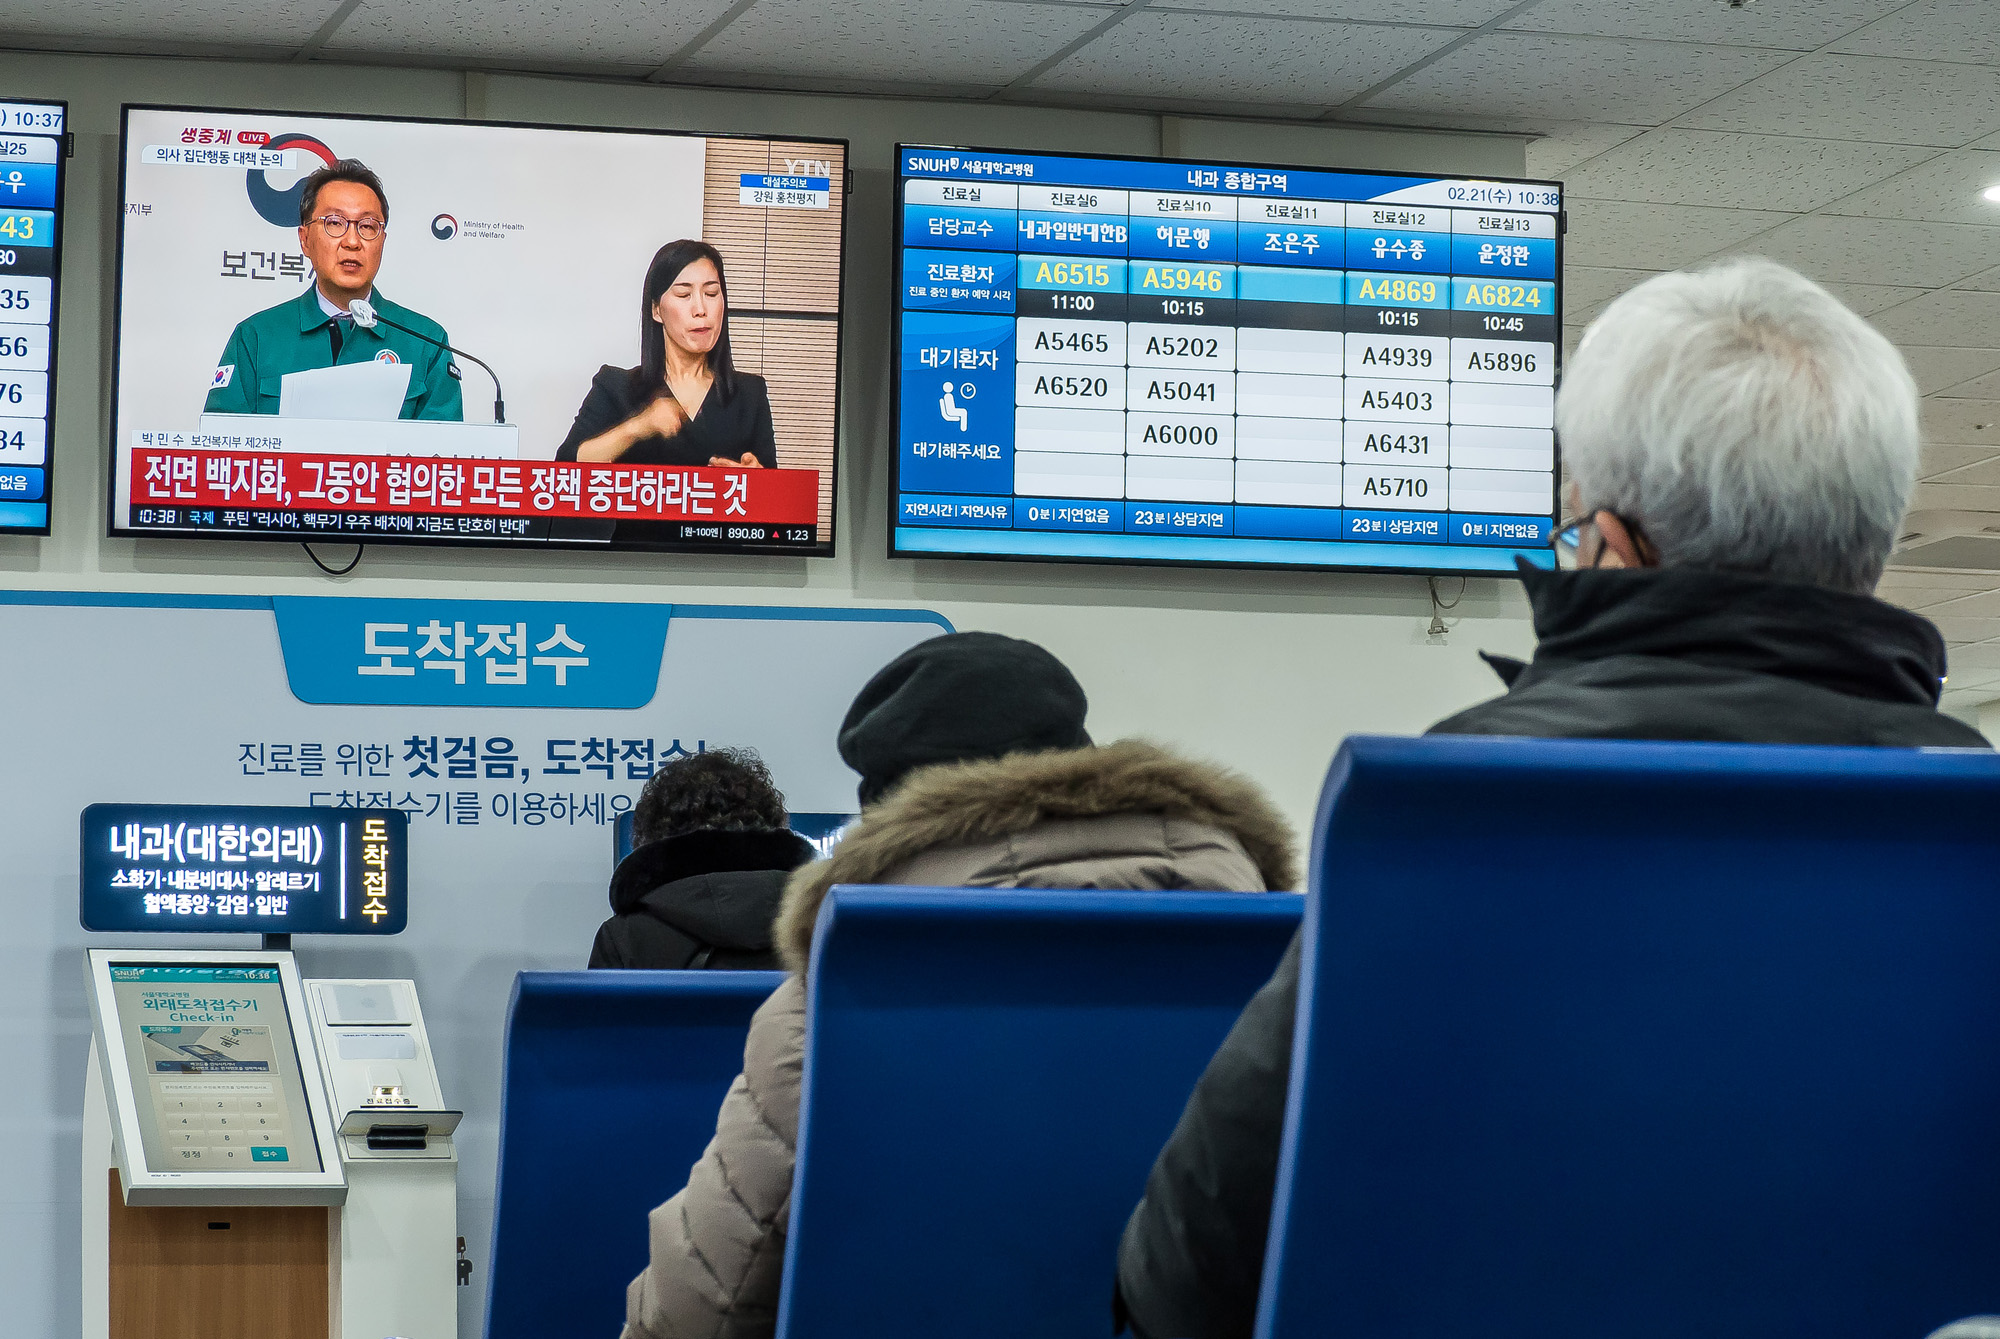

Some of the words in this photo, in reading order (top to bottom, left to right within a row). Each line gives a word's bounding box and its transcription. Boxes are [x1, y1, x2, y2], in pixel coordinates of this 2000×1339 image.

[15, 111, 62, 128] 10:37
[181, 127, 232, 145] 생중계
[242, 133, 266, 143] LIVE
[157, 148, 181, 163] 의사
[184, 149, 231, 165] 집단행동
[233, 151, 257, 167] 대책
[259, 153, 283, 167] 논의
[908, 157, 950, 172] SNUH
[961, 160, 1034, 177] 서울대학교병원
[784, 158, 831, 177] YTN
[0, 170, 26, 194] 우
[762, 176, 808, 188] 대설주의보
[1187, 170, 1219, 188] 내과
[1223, 171, 1288, 192] 종합구역
[753, 190, 774, 203] 강원
[776, 191, 816, 205] 홍천평지
[942, 186, 981, 202] 진료실
[1050, 191, 1098, 208] 진료실6
[1447, 187, 1512, 206] 02.21(수)
[1518, 191, 1559, 206] 10:38
[1156, 198, 1211, 213] 진료실10
[1265, 203, 1317, 220] 진료실11
[463, 220, 491, 230] Ministry
[493, 222, 500, 230] of
[502, 223, 525, 231] Health
[928, 217, 994, 238] 담당교수
[1372, 210, 1425, 226] 진료실12
[1478, 215, 1530, 232] 진료실13
[463, 230, 477, 238] and
[479, 231, 505, 239] Welfare
[1019, 220, 1127, 243] 내과일반대한B
[1156, 225, 1210, 250] 허문행
[1264, 232, 1320, 255] 조은주
[1371, 237, 1426, 261] 유수종
[1478, 243, 1530, 267] 윤정환
[221, 251, 315, 282] 보건복
[927, 263, 994, 284] 진료환자
[1036, 262, 1110, 286] A6515
[1143, 268, 1222, 292] A5946
[0, 289, 30, 310] 35
[909, 286, 927, 296] 진료
[951, 288, 969, 299] 환자
[971, 289, 991, 299] 예약
[993, 290, 1011, 301] 시각
[1359, 278, 1436, 302] A4869
[1465, 284, 1541, 308] A6824
[1051, 294, 1095, 311] 11:00
[1161, 300, 1204, 316] 10:15
[1377, 310, 1419, 327] 10:15
[1482, 316, 1524, 332] 10:45
[0, 336, 28, 357] 56
[1034, 331, 1109, 352] A5465
[1145, 336, 1218, 358] A5202
[920, 346, 999, 371] 대기환자
[1362, 346, 1432, 367] A4939
[1468, 351, 1536, 373] A5896
[1034, 376, 1108, 397] A6520
[1147, 380, 1216, 402] A5041
[1361, 390, 1432, 411] A5403
[191, 435, 241, 448] 보건복지부
[244, 437, 282, 449] 제2차관
[1143, 424, 1218, 446] A6000
[1364, 433, 1429, 454] A6431
[913, 442, 1001, 460] 대기해주세요
[0, 475, 28, 491] 없음
[144, 455, 197, 498] 전면
[206, 457, 292, 507] 백지화,
[299, 461, 379, 505] 그동안
[386, 462, 465, 507] 협의한
[470, 466, 523, 508] 모든
[530, 468, 581, 511] 정책
[588, 470, 716, 515] 중단하라는
[723, 474, 748, 516] 것
[1363, 477, 1428, 497] A5710
[139, 509, 176, 524] 10:38
[905, 503, 953, 517] 지연시간
[960, 504, 1008, 519] 지연사유
[1028, 506, 1051, 522] 0분
[1058, 508, 1110, 524] 지연없음
[1134, 510, 1165, 525] 23분
[1172, 511, 1224, 527] 상담지연
[189, 511, 215, 525] 국제
[222, 511, 249, 527] 푸틴
[253, 512, 300, 528] "러시아,
[303, 512, 342, 529] 핵무기
[345, 514, 371, 530] 우주
[374, 515, 413, 531] 배치에
[416, 516, 454, 532] 지금도
[458, 518, 496, 534] 단호히
[499, 519, 530, 534] 반대"
[1352, 518, 1382, 533] 23분
[1390, 519, 1438, 535] 상담지연
[1462, 521, 1483, 537] 0분
[1490, 522, 1539, 539] 지연없음
[728, 527, 765, 539] 890.80
[786, 529, 809, 541] 1.23
[357, 621, 590, 686] 도착접수
[238, 742, 326, 777] 진료를
[335, 743, 394, 777] 위한
[402, 735, 530, 785] 첫걸음,
[110, 822, 323, 866] 내과(대한외래)
[110, 869, 320, 892] 소화기·내분비대사·알레르기
[361, 818, 389, 924] 도착접수
[244, 972, 270, 980] 10:38
[143, 998, 258, 1012] 외래도착접수기
[169, 1012, 235, 1022] Check-in
[181, 1150, 201, 1158] 정정
[261, 1150, 278, 1158] 접수
